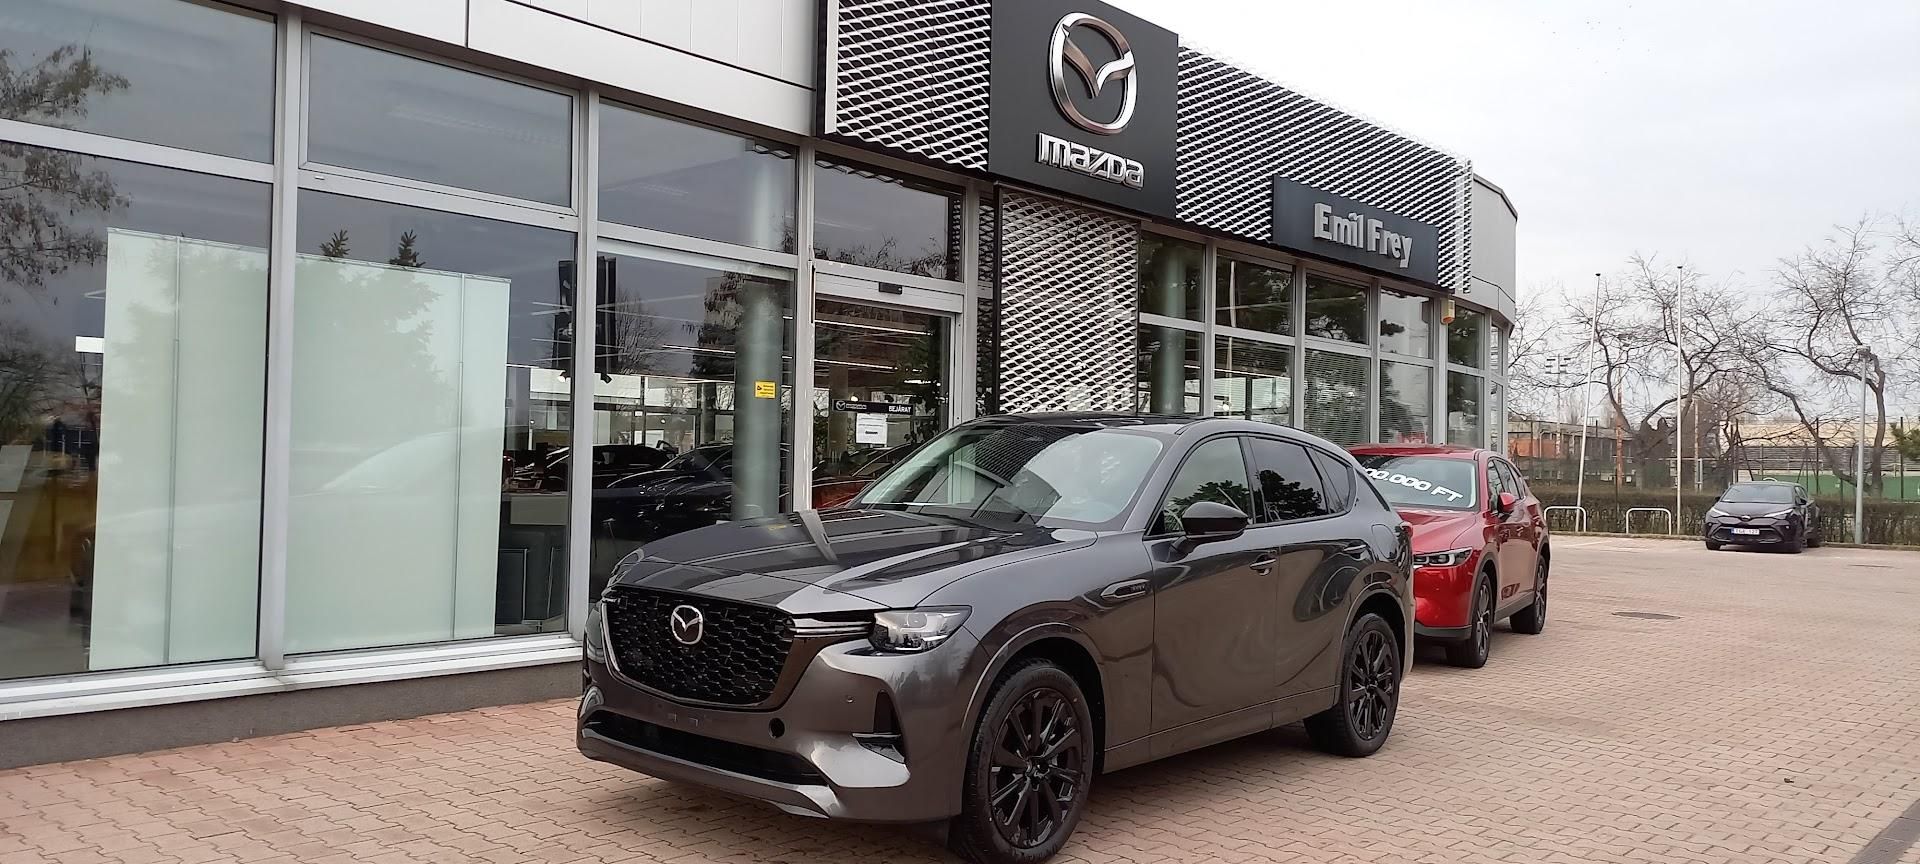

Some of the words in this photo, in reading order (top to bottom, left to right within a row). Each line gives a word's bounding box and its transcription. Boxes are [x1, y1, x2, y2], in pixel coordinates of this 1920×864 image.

[1313, 202, 1364, 249] Emil
[1366, 218, 1413, 269] Frey
[1363, 466, 1432, 491] 00.000
[1431, 484, 1464, 502] FT
